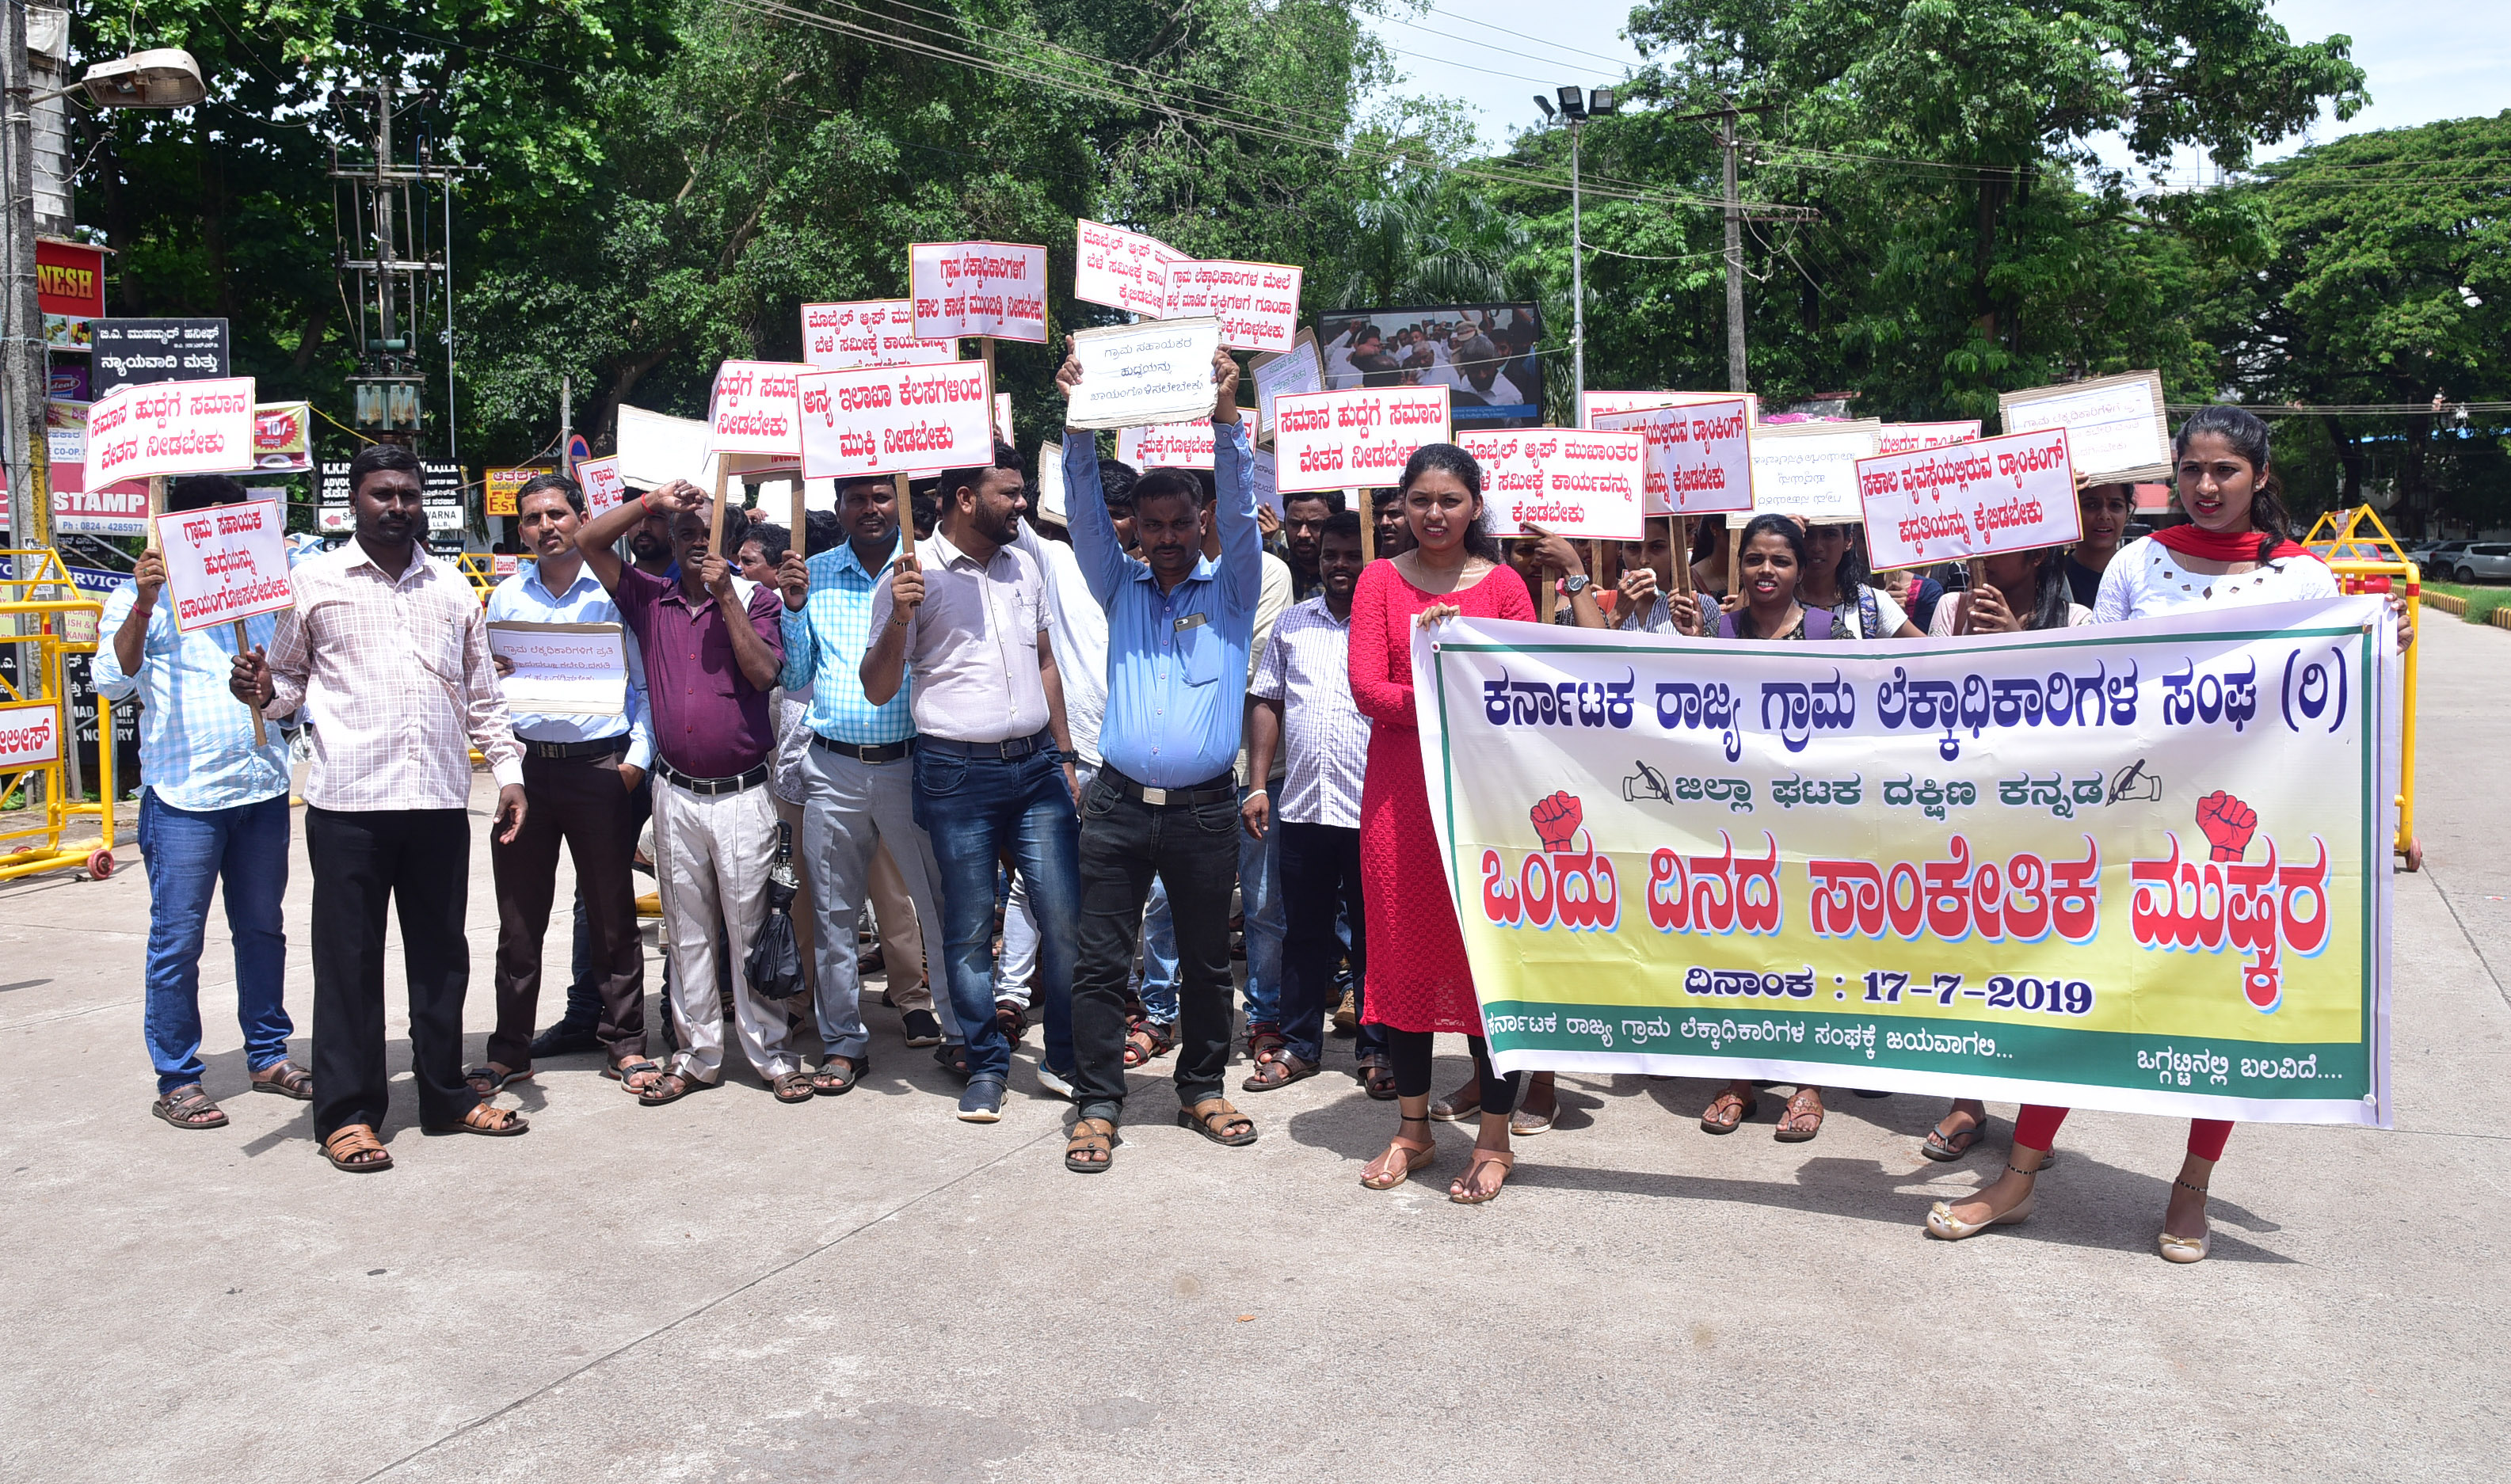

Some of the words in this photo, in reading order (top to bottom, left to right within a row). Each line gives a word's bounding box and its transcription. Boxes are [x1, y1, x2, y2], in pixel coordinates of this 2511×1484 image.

[940, 252, 961, 287] ಗ್ರಾಮ
[963, 251, 1026, 289] ಲೆಕ್ಕಾಧಿಕಾರಿಗಳಿಗೆ
[1173, 268, 1191, 288] ಗ್ರಾಮ
[1195, 267, 1258, 291] ಲೆಕ್ಕಾಧಿಕಾರಿಗಳ
[1263, 272, 1290, 290] ಮೇಲೆ
[916, 298, 939, 318] ಕಾಲ
[969, 289, 1003, 325] ಮುಂಬಡ್ತಿ
[1007, 293, 1042, 320] ನೀಡಬೇಕು
[1182, 292, 1207, 307] ಮಾಡಿದ
[1210, 291, 1252, 316] ವ್ಯಕ್ತಿಗಳಿಗೆ
[1256, 296, 1292, 314] ಗೂಂಡಾ
[809, 308, 853, 335] ಮೊಬೈಲ್
[1221, 317, 1285, 345] ಕೈಗೊಳ್ಳಬೇಕು
[815, 336, 833, 353] ಬೆಳೆ
[840, 333, 878, 358] ಸಮೀಕ್ಷೆ
[1104, 344, 1133, 360] ಗ್ರಾಮ
[1137, 337, 1192, 352] ಸಹಾಯಕರ
[101, 353, 177, 377] ನ್ಯಾಯವಾದಿ
[184, 353, 218, 373] ಮತ್ತು
[51, 379, 76, 390] deal
[804, 382, 834, 428] ಅನ್ಯ
[839, 383, 892, 413] ಇಲಾಖಾ
[899, 370, 982, 405] ಕೆಲಸಗಳಿಂದ
[91, 398, 127, 438] ಸಮಾನ
[135, 391, 181, 428] ಹುದ್ದೆಗೆ
[190, 388, 246, 416] ಸಮಾನ
[717, 410, 788, 436] ನೀಡಬೇಕು
[1281, 400, 1330, 432] ಸಮಾನ
[1338, 398, 1381, 439] ಹುದ್ದೆಗೆ
[1389, 396, 1442, 424] ಸಮಾನ
[101, 433, 138, 470] ವೇತನ
[147, 428, 224, 457] ನೀಡಬೇಕು
[839, 426, 877, 466] ಮುಕ್ತಿ
[884, 419, 953, 454] ನೀಡಬೇಕು
[1299, 443, 1343, 473] ವೇತನ
[1465, 439, 1518, 469] ಮೊಬೈಲ್
[1564, 439, 1638, 462] ಮುಖಾಂತರ
[590, 465, 615, 487] ಗ್ರಾಮ
[1480, 470, 1491, 491] ಳೆ
[1498, 470, 1544, 500] ಸಮೀಕ್ಷೆ
[1552, 470, 1632, 502] ಕಾರ್ಯವನ್ನು
[1673, 461, 1725, 505] ಕೈಬಿಡಬೇಕು
[1862, 468, 1898, 497] ಸಕಾಲ
[1901, 449, 1992, 504] ವ್ಯವಸ್ಥೆಯಲ್ಲಿರುವ
[54, 492, 145, 513] STAMP
[592, 489, 610, 509] ಹಲ್ಲೆ
[1813, 492, 1842, 505] ಗ್ರಾಮ
[80, 522, 101, 531] 0824
[108, 523, 143, 532] 4285977
[183, 513, 212, 549] ಗ್ರಾಮ
[216, 505, 262, 535] ಸಹಾಯಕ
[1511, 501, 1584, 531] ಕೈಬಿಡಬೇಕು
[1898, 506, 1972, 557] ಪದ್ಧತಿಯನ್ನು
[1973, 494, 2043, 545] ಕೈಬಿಡಬೇಕು
[204, 543, 257, 584] ಹುದ್ದೆಯನ್ನು
[504, 645, 527, 655] ಗ್ರಾಮ
[596, 647, 614, 657] ಪ್ರತಿ
[1484, 665, 1635, 729] ಕರ್ನಾಟಕ
[1656, 683, 1741, 762] ರಾಜ್ಯ
[1761, 667, 1857, 753] ಗ್ರಾಮ
[1877, 657, 2138, 762] ಲೆಕ್ಕಾಧಿಕಾರಿಗಳ
[2162, 656, 2257, 732] ಸಂಘ
[2281, 646, 2348, 733] (ರಿ)
[1675, 774, 1753, 812] ಜಿಲ್ಲಾ
[1771, 772, 1861, 808] ಘಟಕ
[1883, 772, 1976, 820] ದಕ್ಷಿಣ
[1999, 770, 2103, 818] ಕನ್ನಡ
[1480, 826, 1621, 932] ಒಂದು
[1646, 828, 1782, 938] ದಿನದ
[1808, 832, 2101, 946] ಸಾಂಕೇತಿಕ
[2130, 830, 2331, 1014] ಮುಷ್ಕರ
[1685, 965, 1816, 999] ದಿನಾಂಕ
[1863, 972, 2094, 1014] 17-7-2019
[1488, 1012, 1557, 1036] ಕರ್ನಾಟಕ
[1566, 1018, 1613, 1047] ರಾಜ್ಯ
[1621, 1017, 1671, 1045] ಗ್ರಾಮ
[1680, 1018, 1804, 1050] ಲೆಕ್ಕಾಧಿಕಾರಿಗಳ
[1815, 1022, 1876, 1060] ಸಂಘಕ್ಕೆ
[1886, 1031, 2013, 1060] ಜಯವಾಗಲಿ...
[2138, 1046, 2229, 1086] ಒಗ್ಗಟ್ಟಿನಲ್ಲಿ
[2241, 1054, 2342, 1080] ಬಲವಿದೆ....
